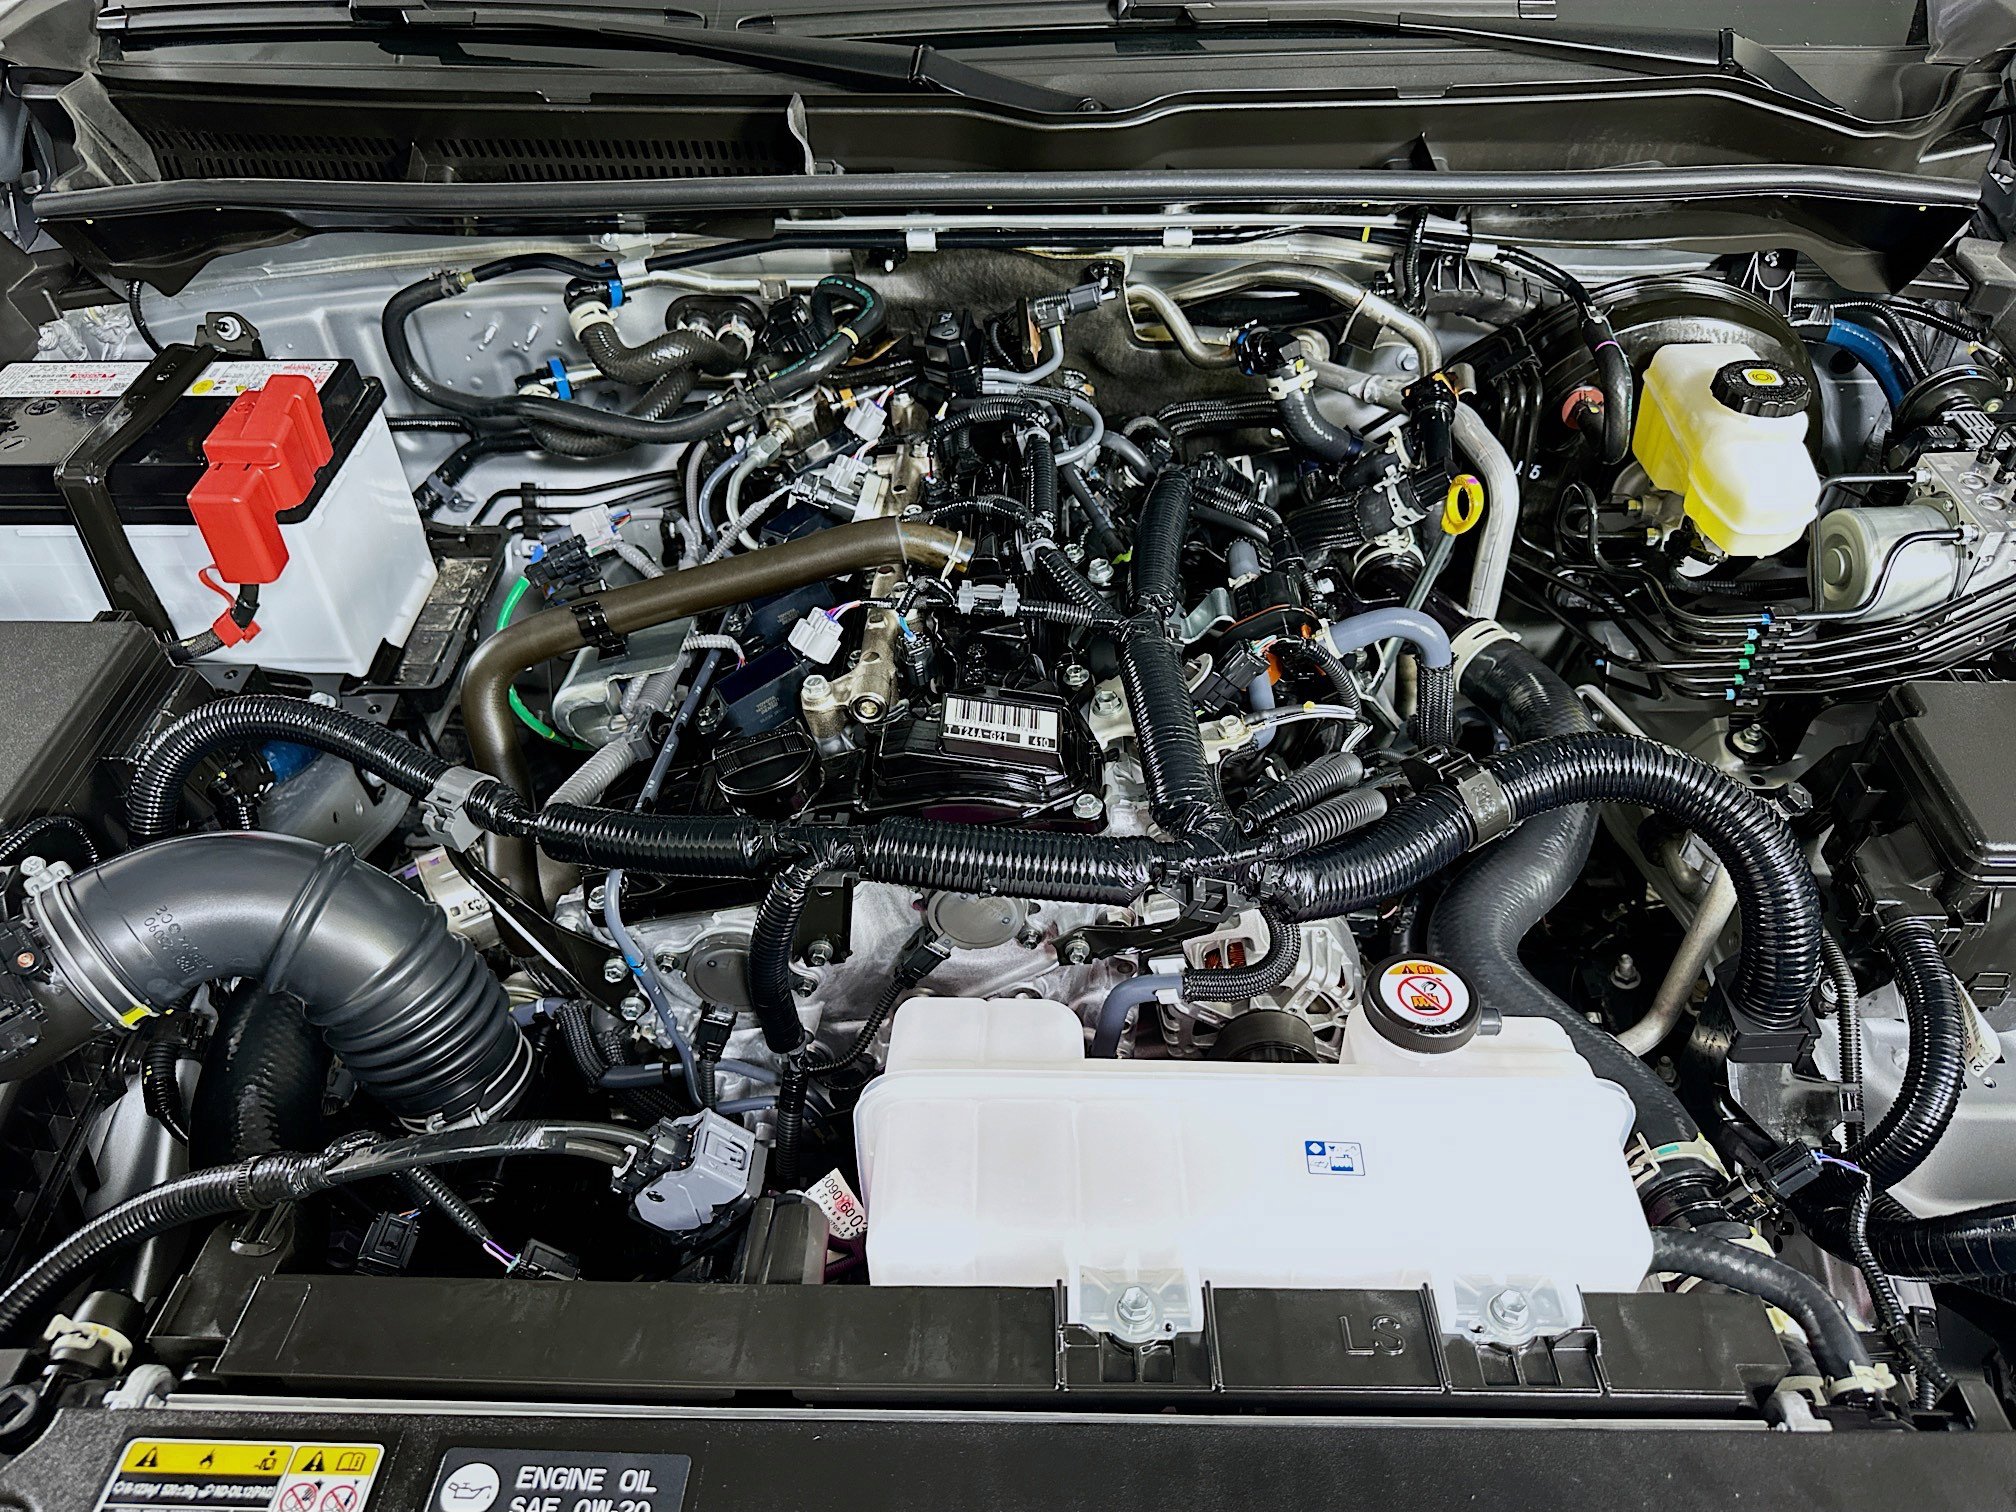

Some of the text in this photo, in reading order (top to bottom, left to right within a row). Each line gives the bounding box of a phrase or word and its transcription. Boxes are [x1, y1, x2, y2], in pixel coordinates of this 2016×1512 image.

[958, 727, 1008, 742] T24A-G21
[1032, 738, 1050, 748] 410
[1340, 1315, 1407, 1356] LS
[515, 1465, 658, 1494] ENGINE OIL
[508, 1496, 562, 1512] SAE
